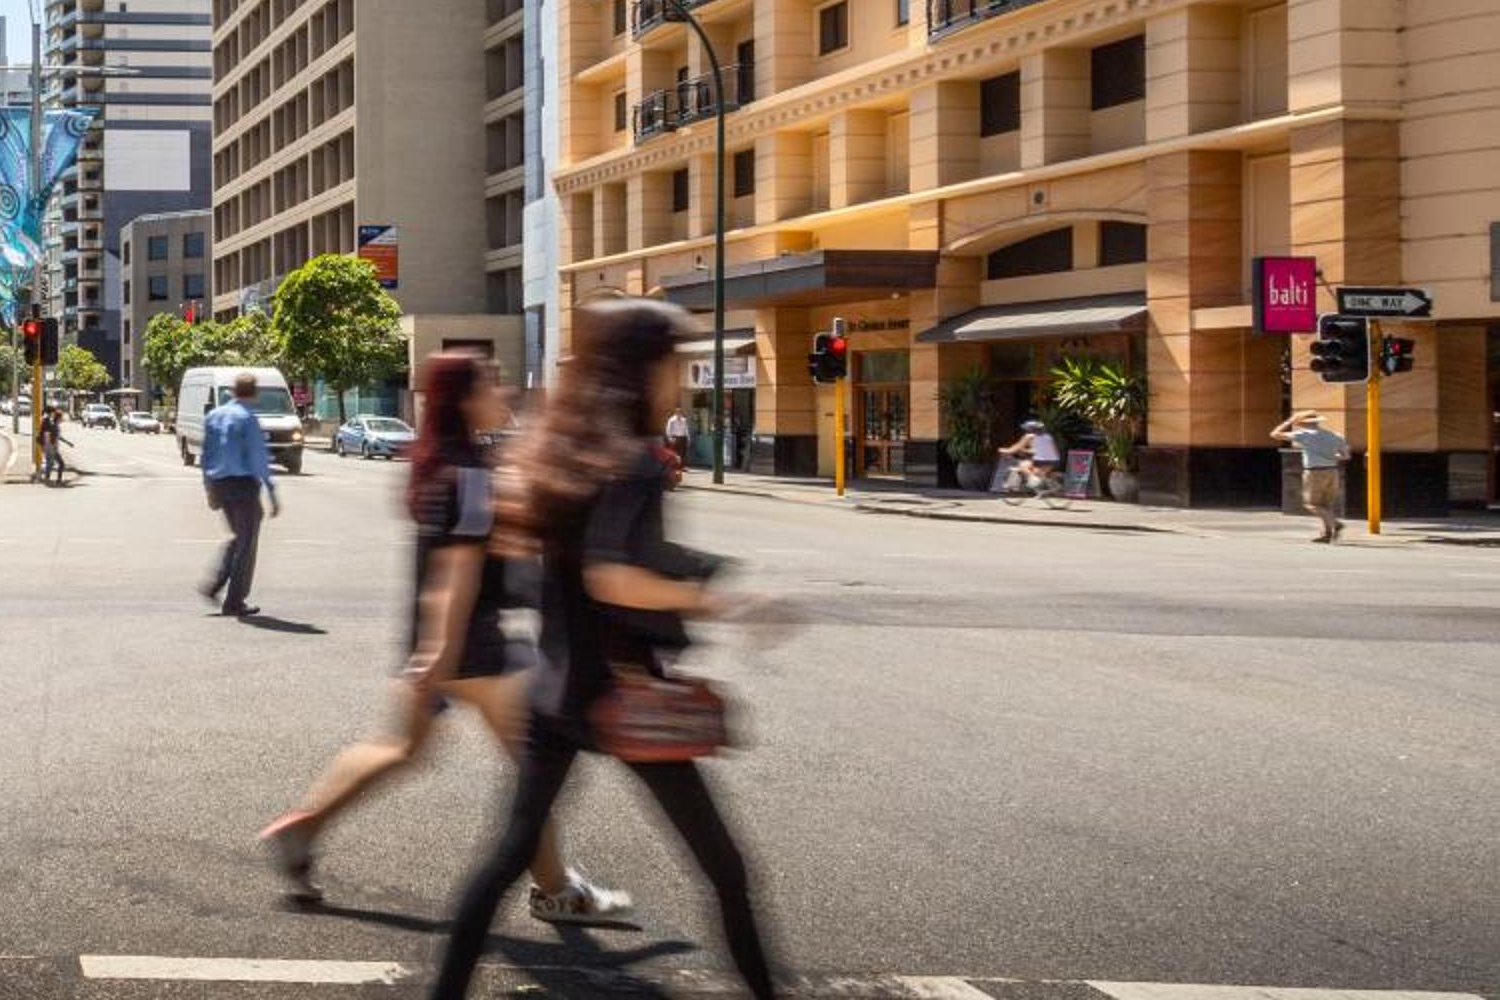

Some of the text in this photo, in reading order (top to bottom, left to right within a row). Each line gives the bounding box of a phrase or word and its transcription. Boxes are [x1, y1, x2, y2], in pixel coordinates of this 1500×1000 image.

[1269, 273, 1308, 305] balti
[1350, 297, 1404, 309] ONE WAY
